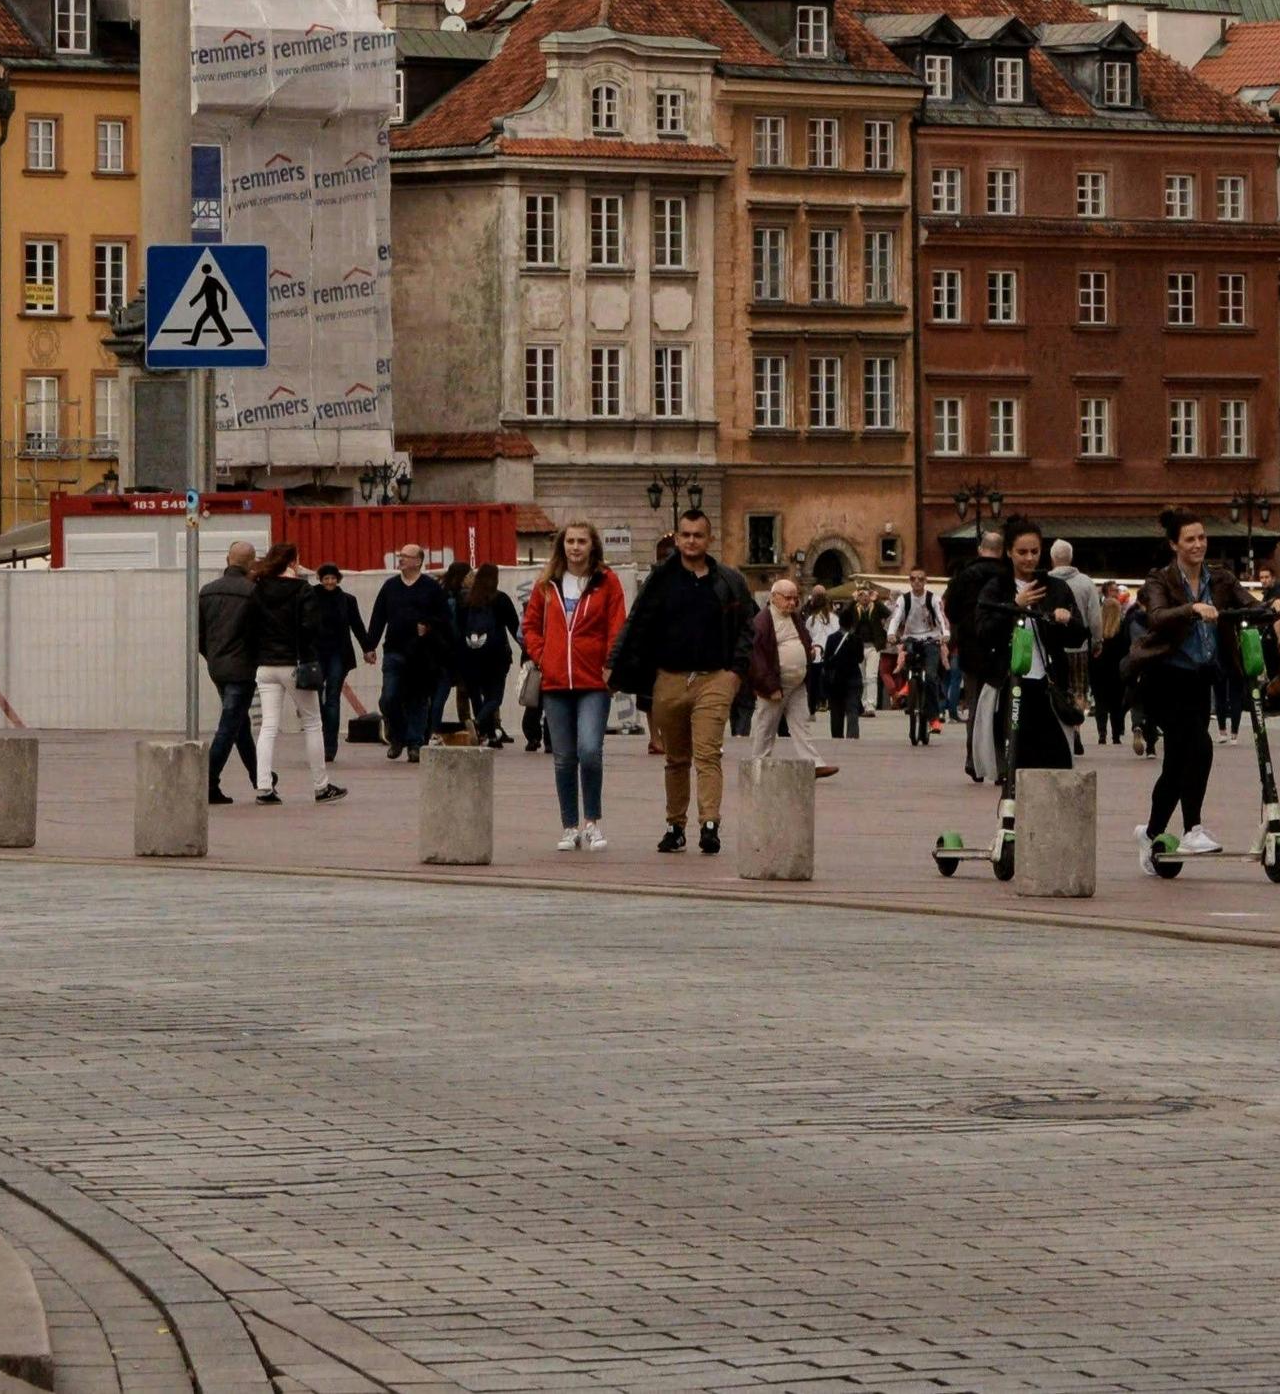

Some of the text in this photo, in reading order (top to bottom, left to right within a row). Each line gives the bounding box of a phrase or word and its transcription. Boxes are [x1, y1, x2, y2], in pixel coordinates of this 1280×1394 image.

[191, 40, 265, 65] remmers
[273, 32, 348, 59] remmers
[232, 166, 305, 193] remmers
[237, 398, 309, 427] remmers
